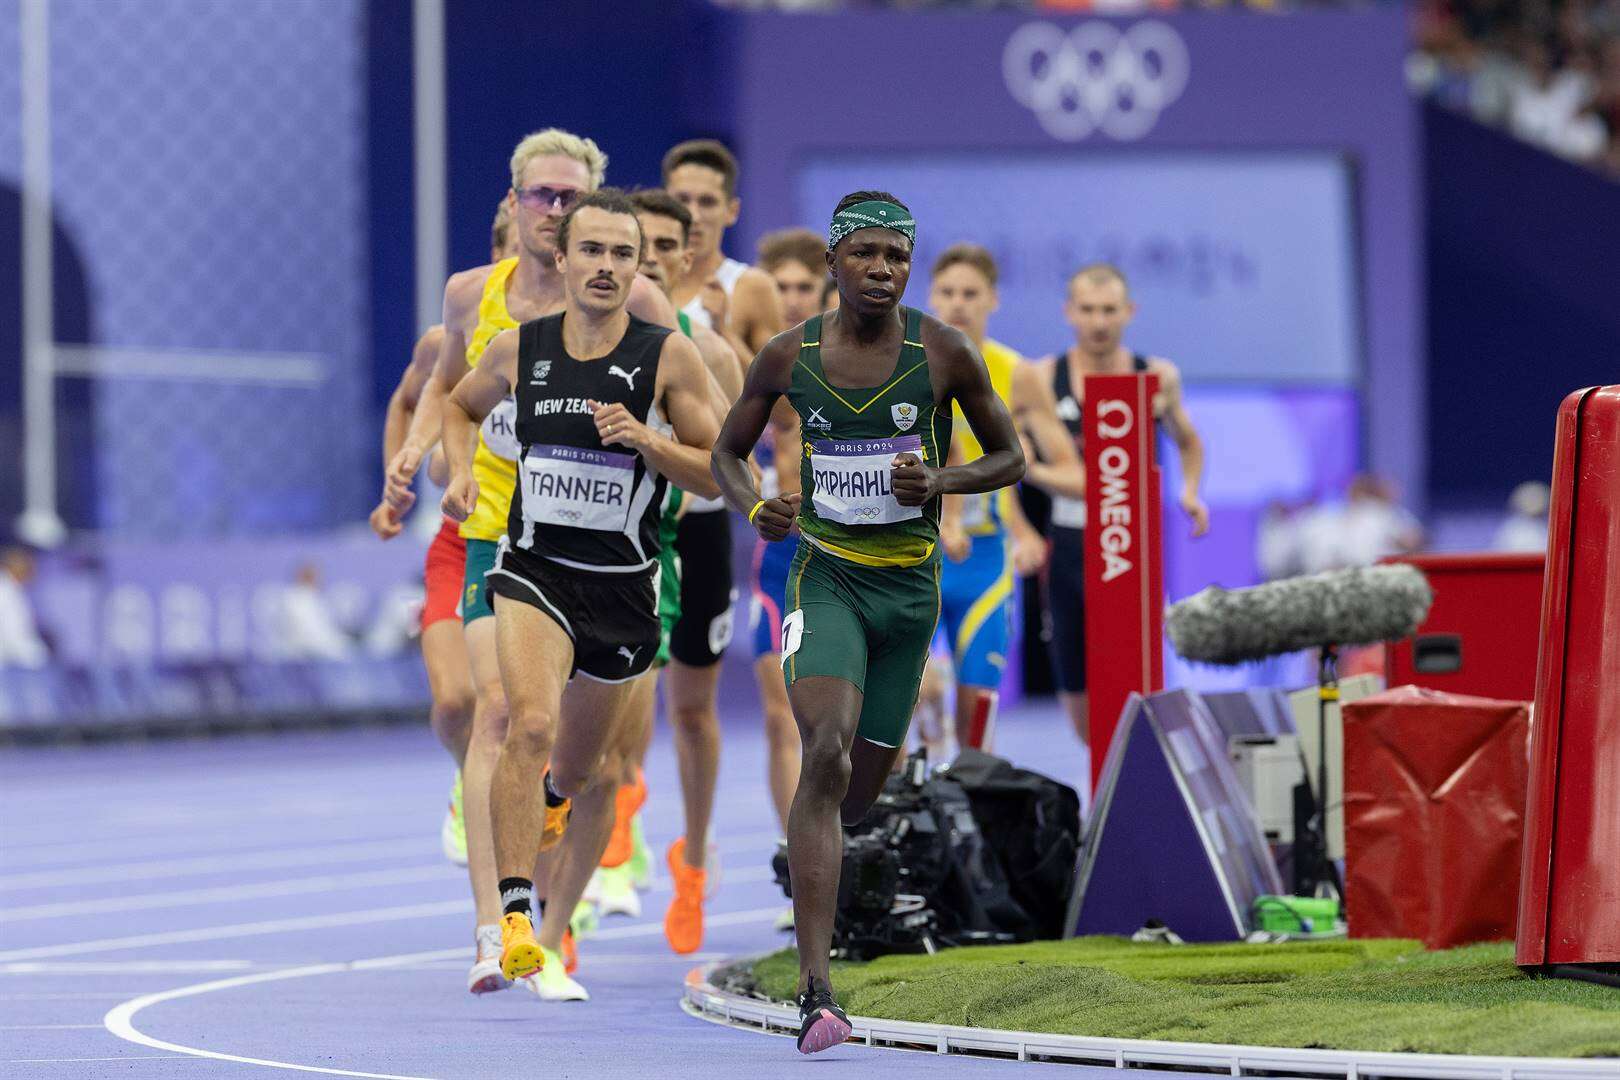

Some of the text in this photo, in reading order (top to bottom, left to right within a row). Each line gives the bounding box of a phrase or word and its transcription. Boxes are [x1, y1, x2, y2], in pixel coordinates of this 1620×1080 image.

[534, 397, 612, 416] NEW ZEAL
[552, 448, 607, 463] PARIS 2024
[835, 442, 893, 452] PARIS 2024
[529, 471, 623, 506] TANNER
[815, 469, 893, 498] MPHAHL
[1098, 446, 1134, 583] OMEGA
